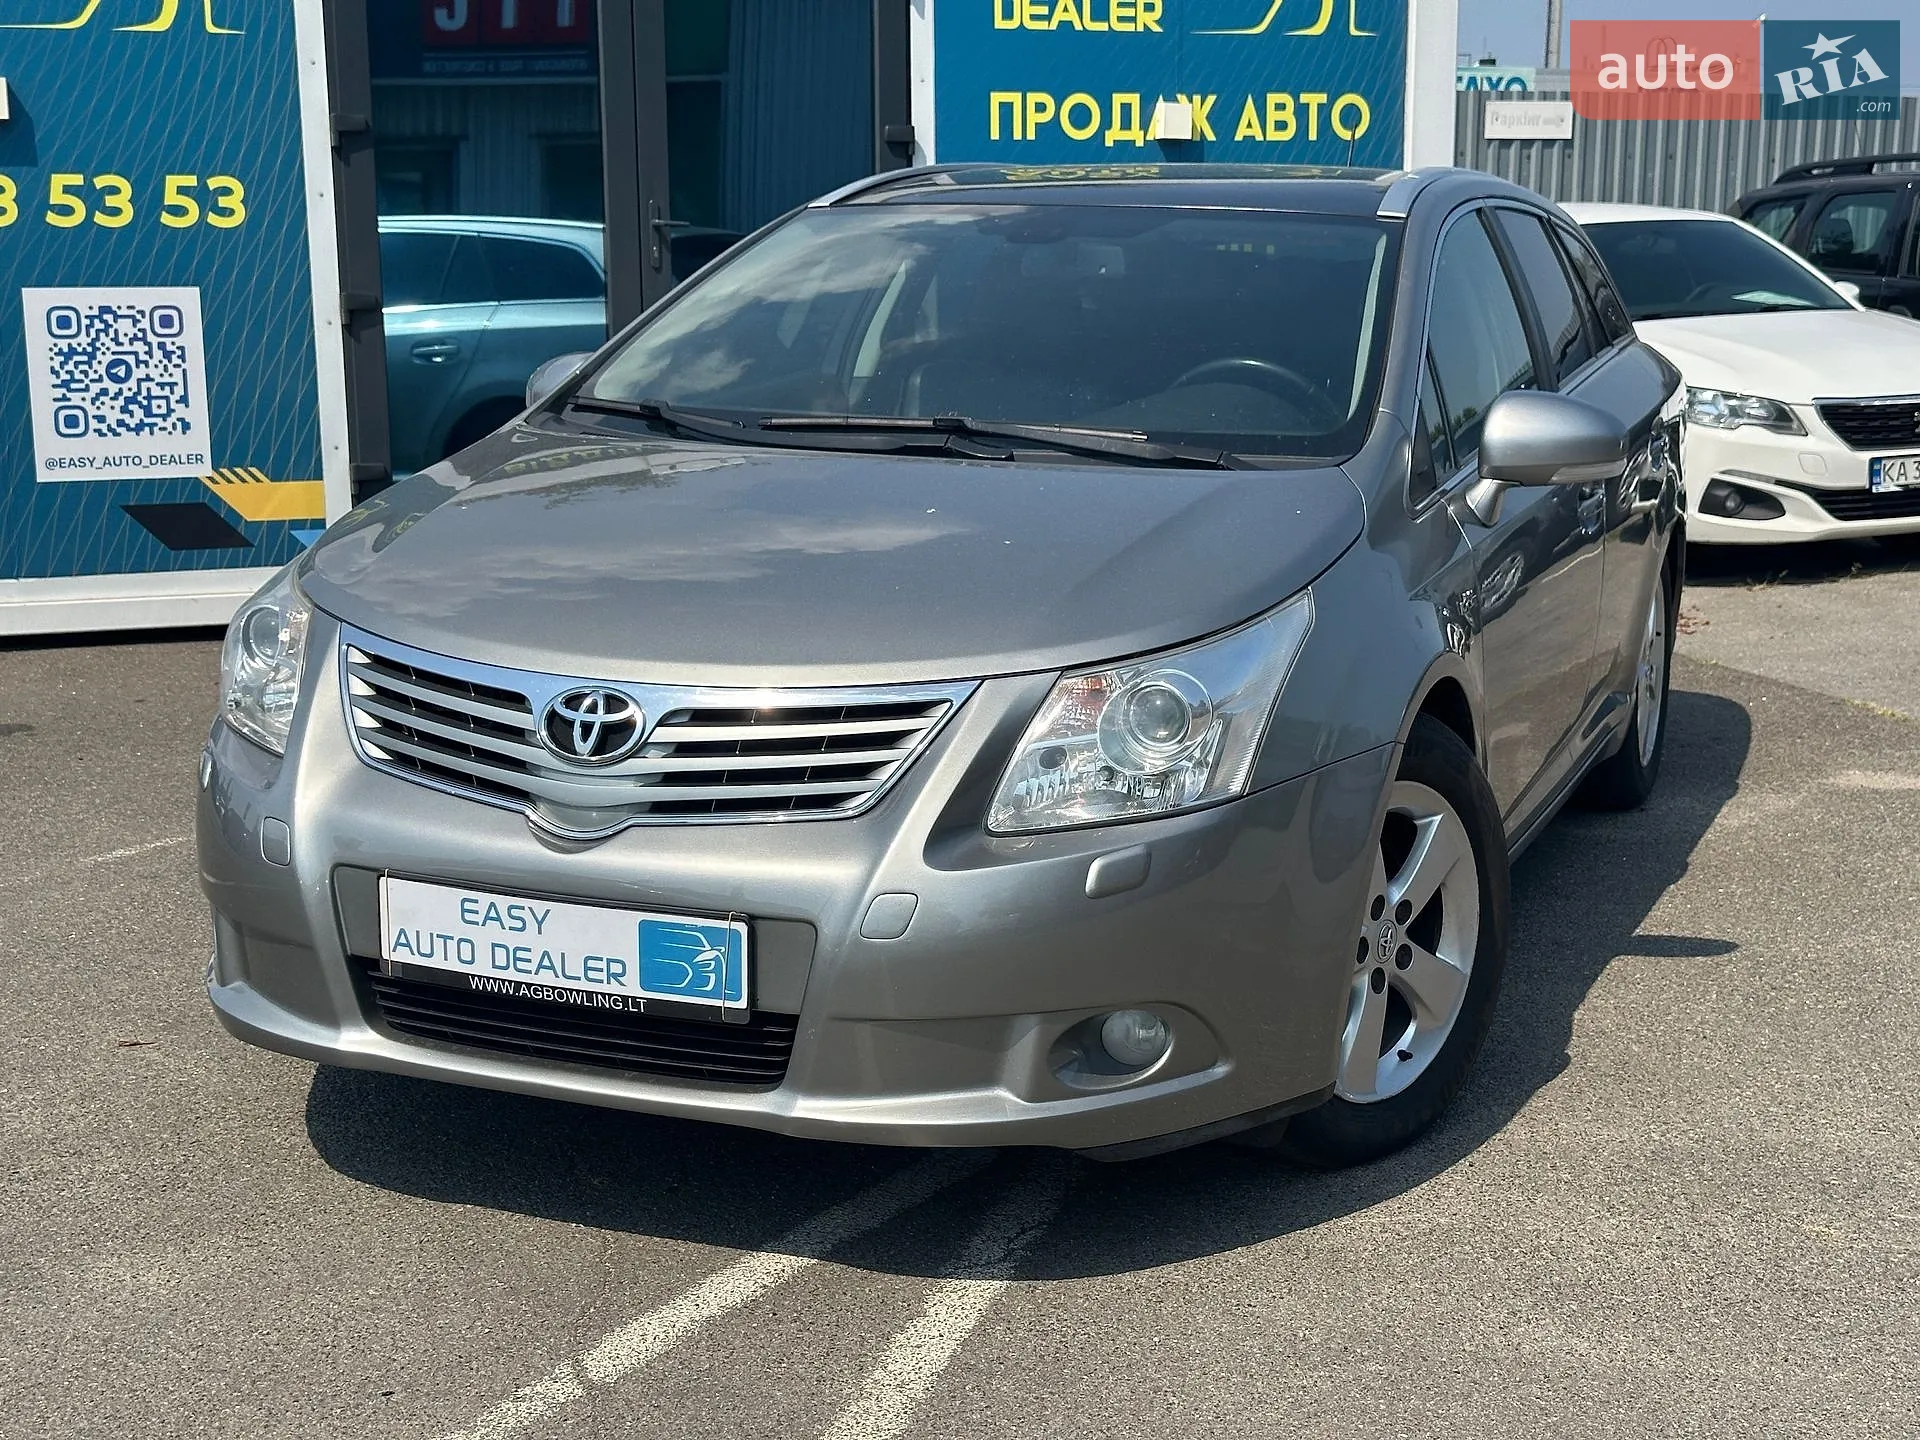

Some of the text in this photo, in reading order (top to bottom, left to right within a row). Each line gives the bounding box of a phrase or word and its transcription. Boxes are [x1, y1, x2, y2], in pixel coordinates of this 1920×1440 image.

[993, 0, 1164, 33] DEALER
[1233, 93, 1372, 141] АВТО
[45, 173, 134, 228] 53
[160, 175, 246, 229] 53
[45, 453, 204, 470] @EASY_AUTO_DEALER
[1883, 461, 1908, 482] KA
[460, 896, 551, 935] EASY
[391, 927, 627, 987] AUTO DEALER
[469, 975, 647, 1013] WWW.AGBOWLING.LT
